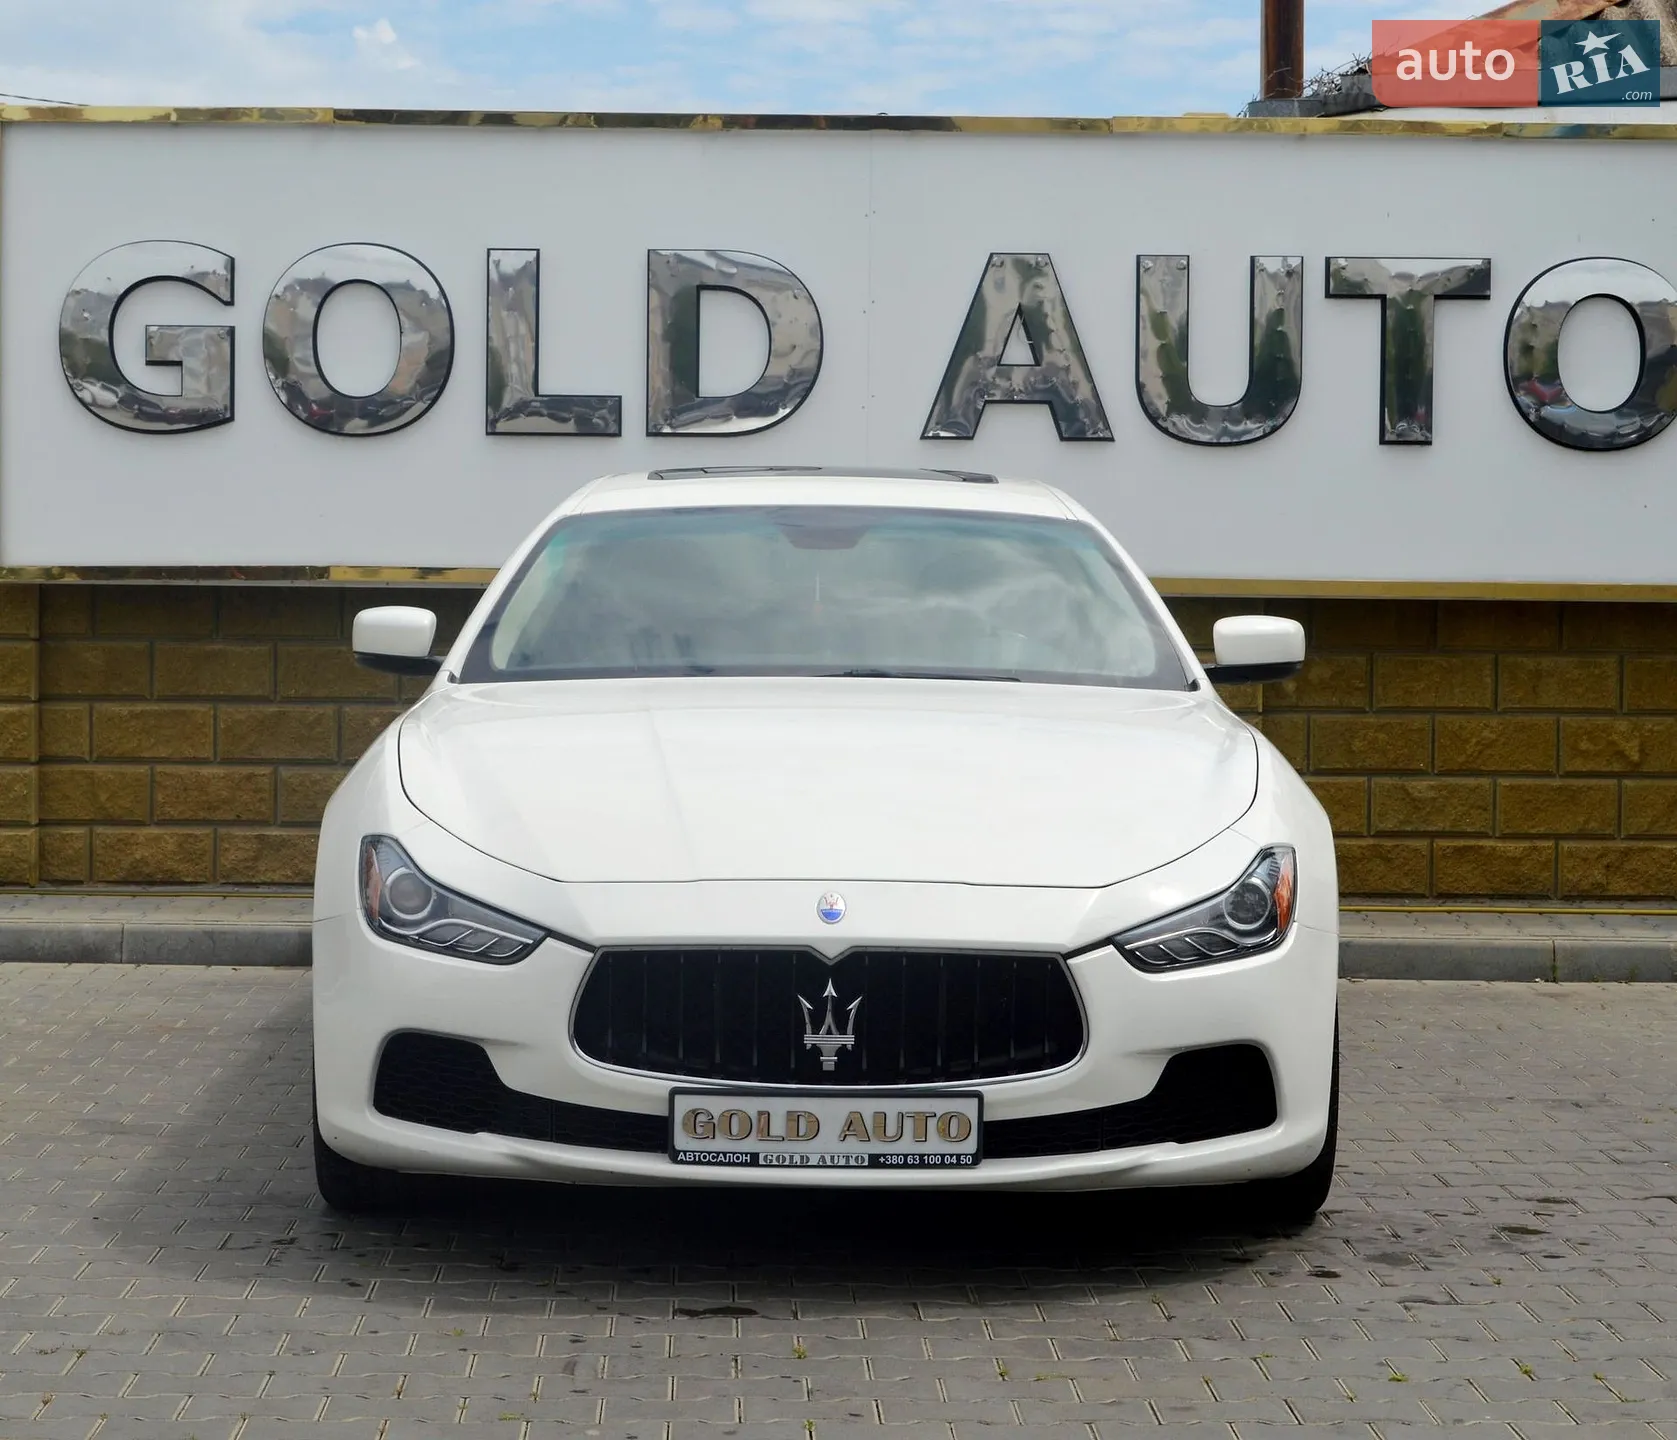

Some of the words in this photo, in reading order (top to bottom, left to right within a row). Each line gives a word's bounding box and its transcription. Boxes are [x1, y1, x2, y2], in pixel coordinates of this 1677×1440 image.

[59, 239, 824, 437] GOLD
[920, 252, 1677, 451] AUTO
[682, 1107, 820, 1142] GOLD
[839, 1110, 972, 1143] AUTO
[677, 1152, 751, 1164] АВТОСАЛОН
[762, 1154, 811, 1165] GOLD
[816, 1154, 867, 1165] AUTO
[878, 1155, 904, 1165] +380
[907, 1155, 920, 1165] 63
[923, 1155, 942, 1165] 100
[944, 1155, 957, 1165] 04
[959, 1155, 973, 1165] 50
